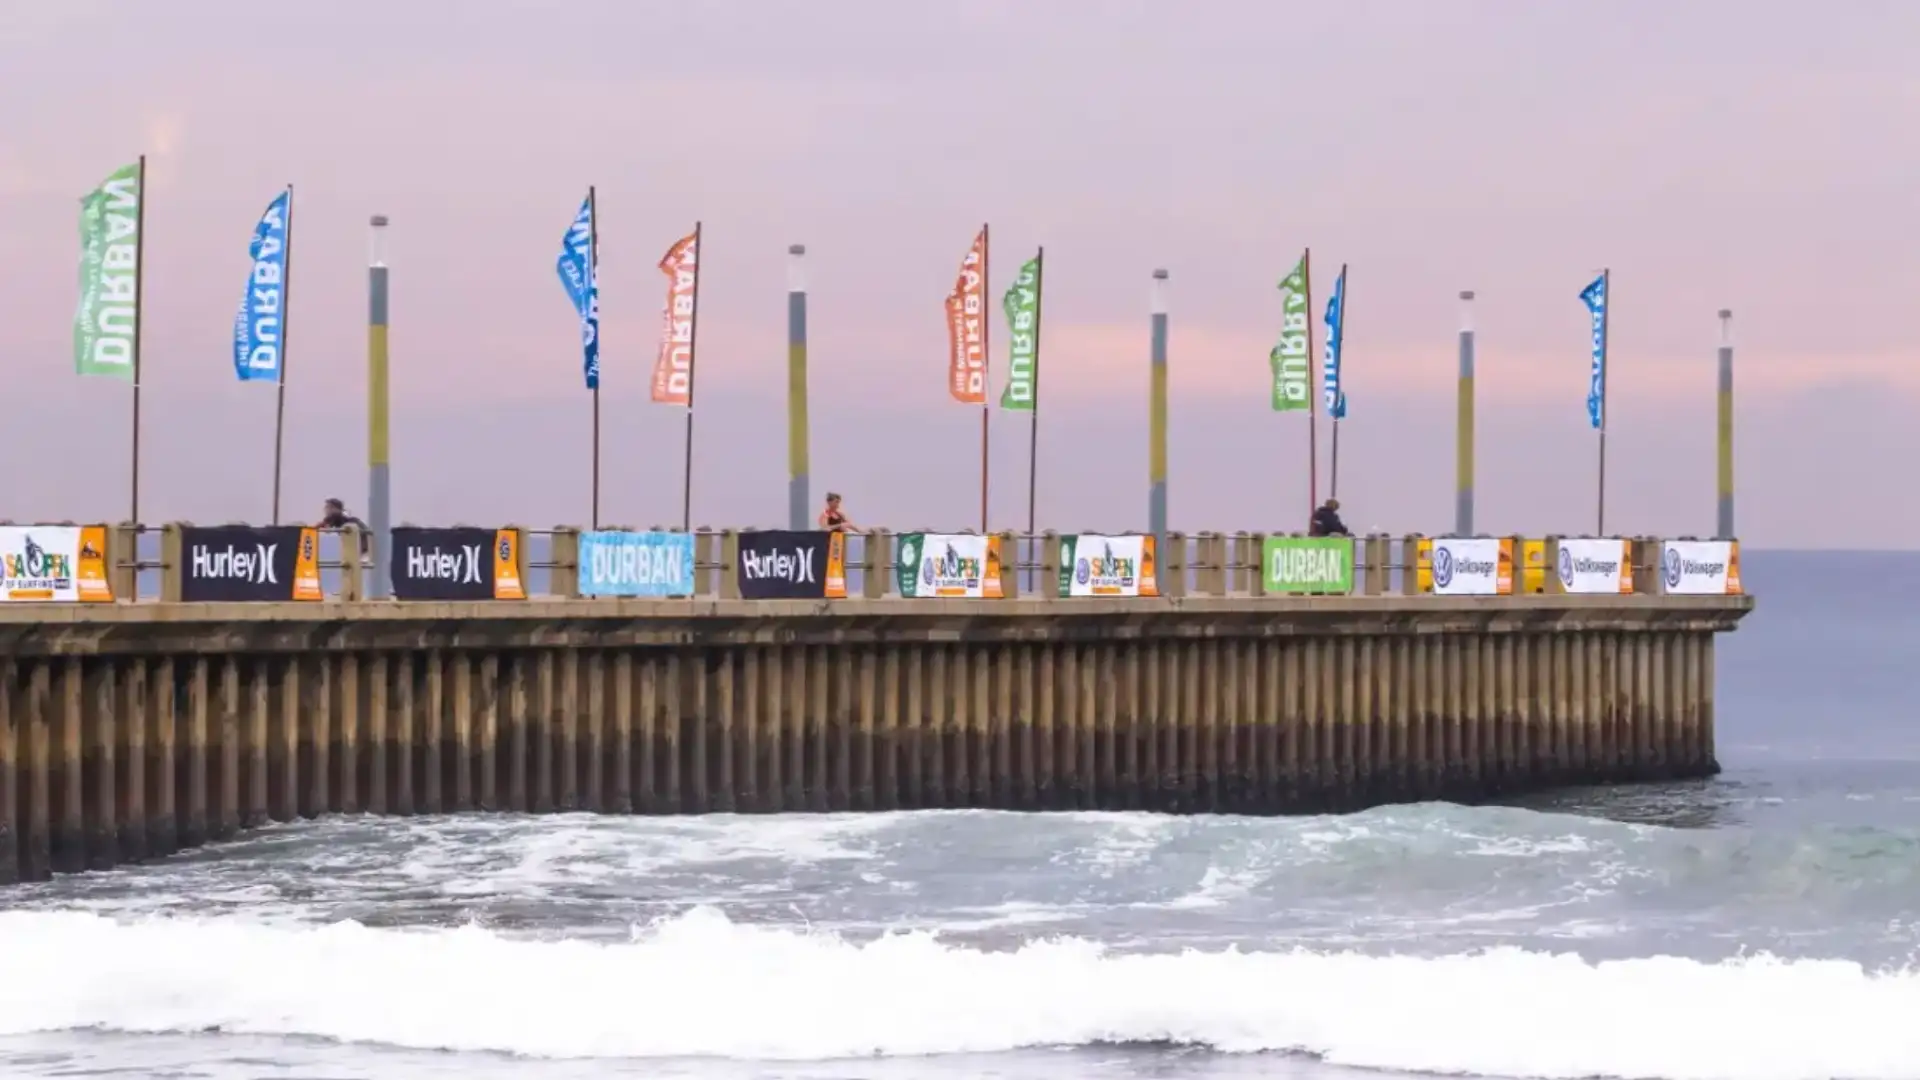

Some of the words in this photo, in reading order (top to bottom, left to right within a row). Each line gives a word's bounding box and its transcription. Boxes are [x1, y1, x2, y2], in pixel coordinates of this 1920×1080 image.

[6, 554, 26, 577] SA
[192, 545, 255, 583] Hurley
[408, 545, 462, 583] Hurley
[592, 543, 682, 585] DURBAN
[742, 547, 797, 583] Hurley
[1271, 547, 1342, 584] DURBAN
